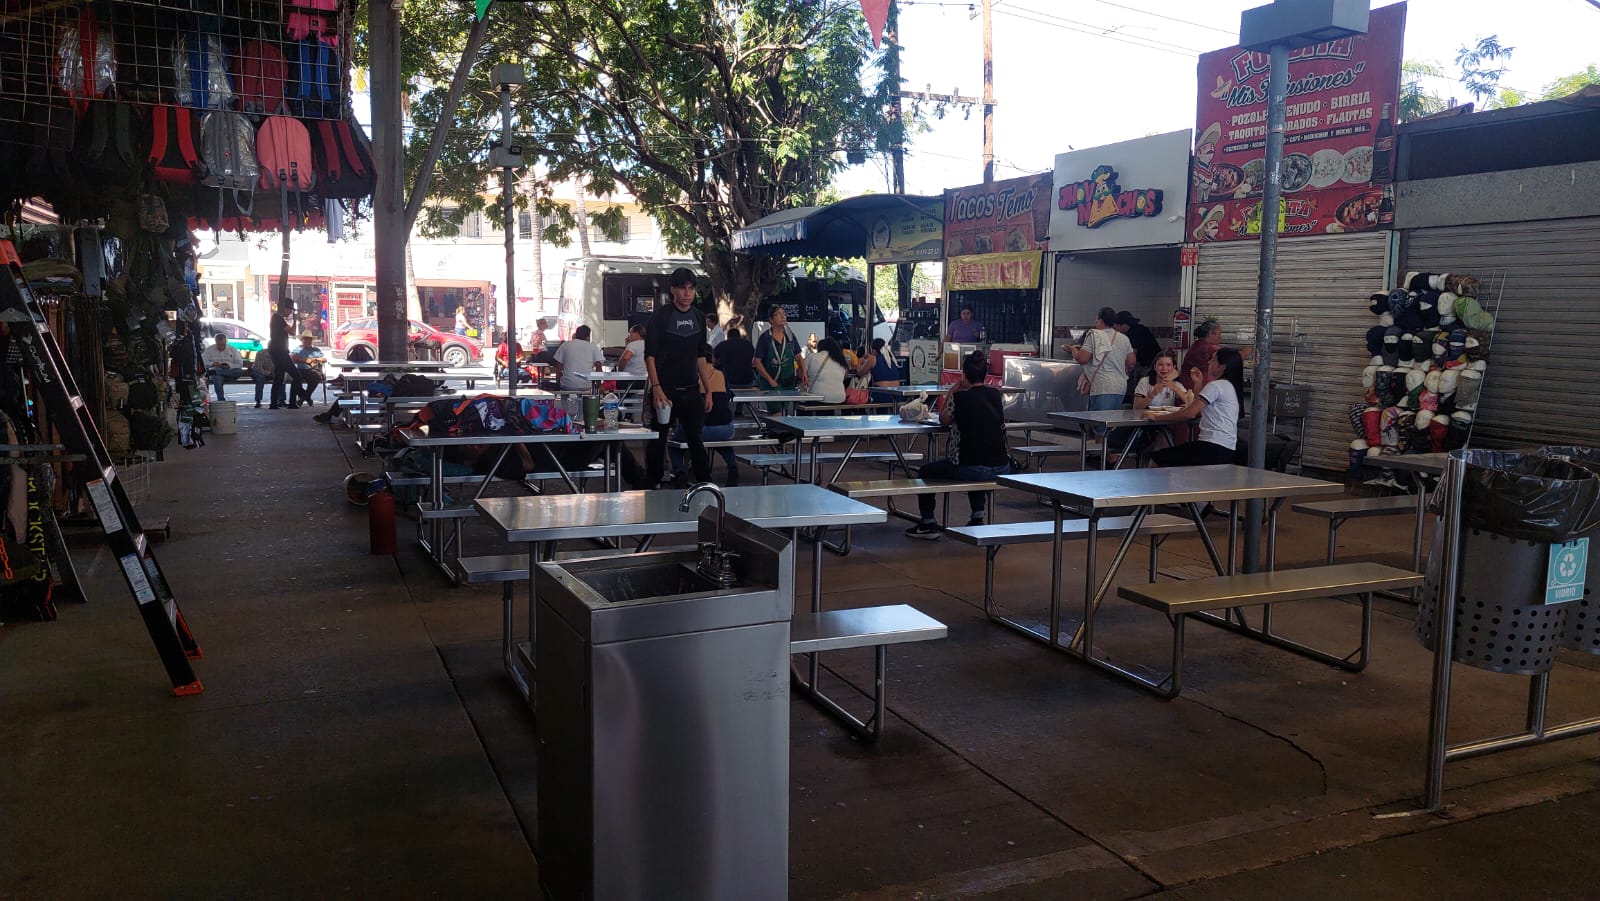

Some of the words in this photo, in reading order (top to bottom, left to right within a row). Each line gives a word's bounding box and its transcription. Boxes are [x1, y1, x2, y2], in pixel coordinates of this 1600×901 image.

[1285, 100, 1321, 118] ENUDO
[1330, 91, 1371, 110] BIRRIA
[1326, 107, 1373, 126] FLAUTAS
[950, 191, 995, 222] Tacos
